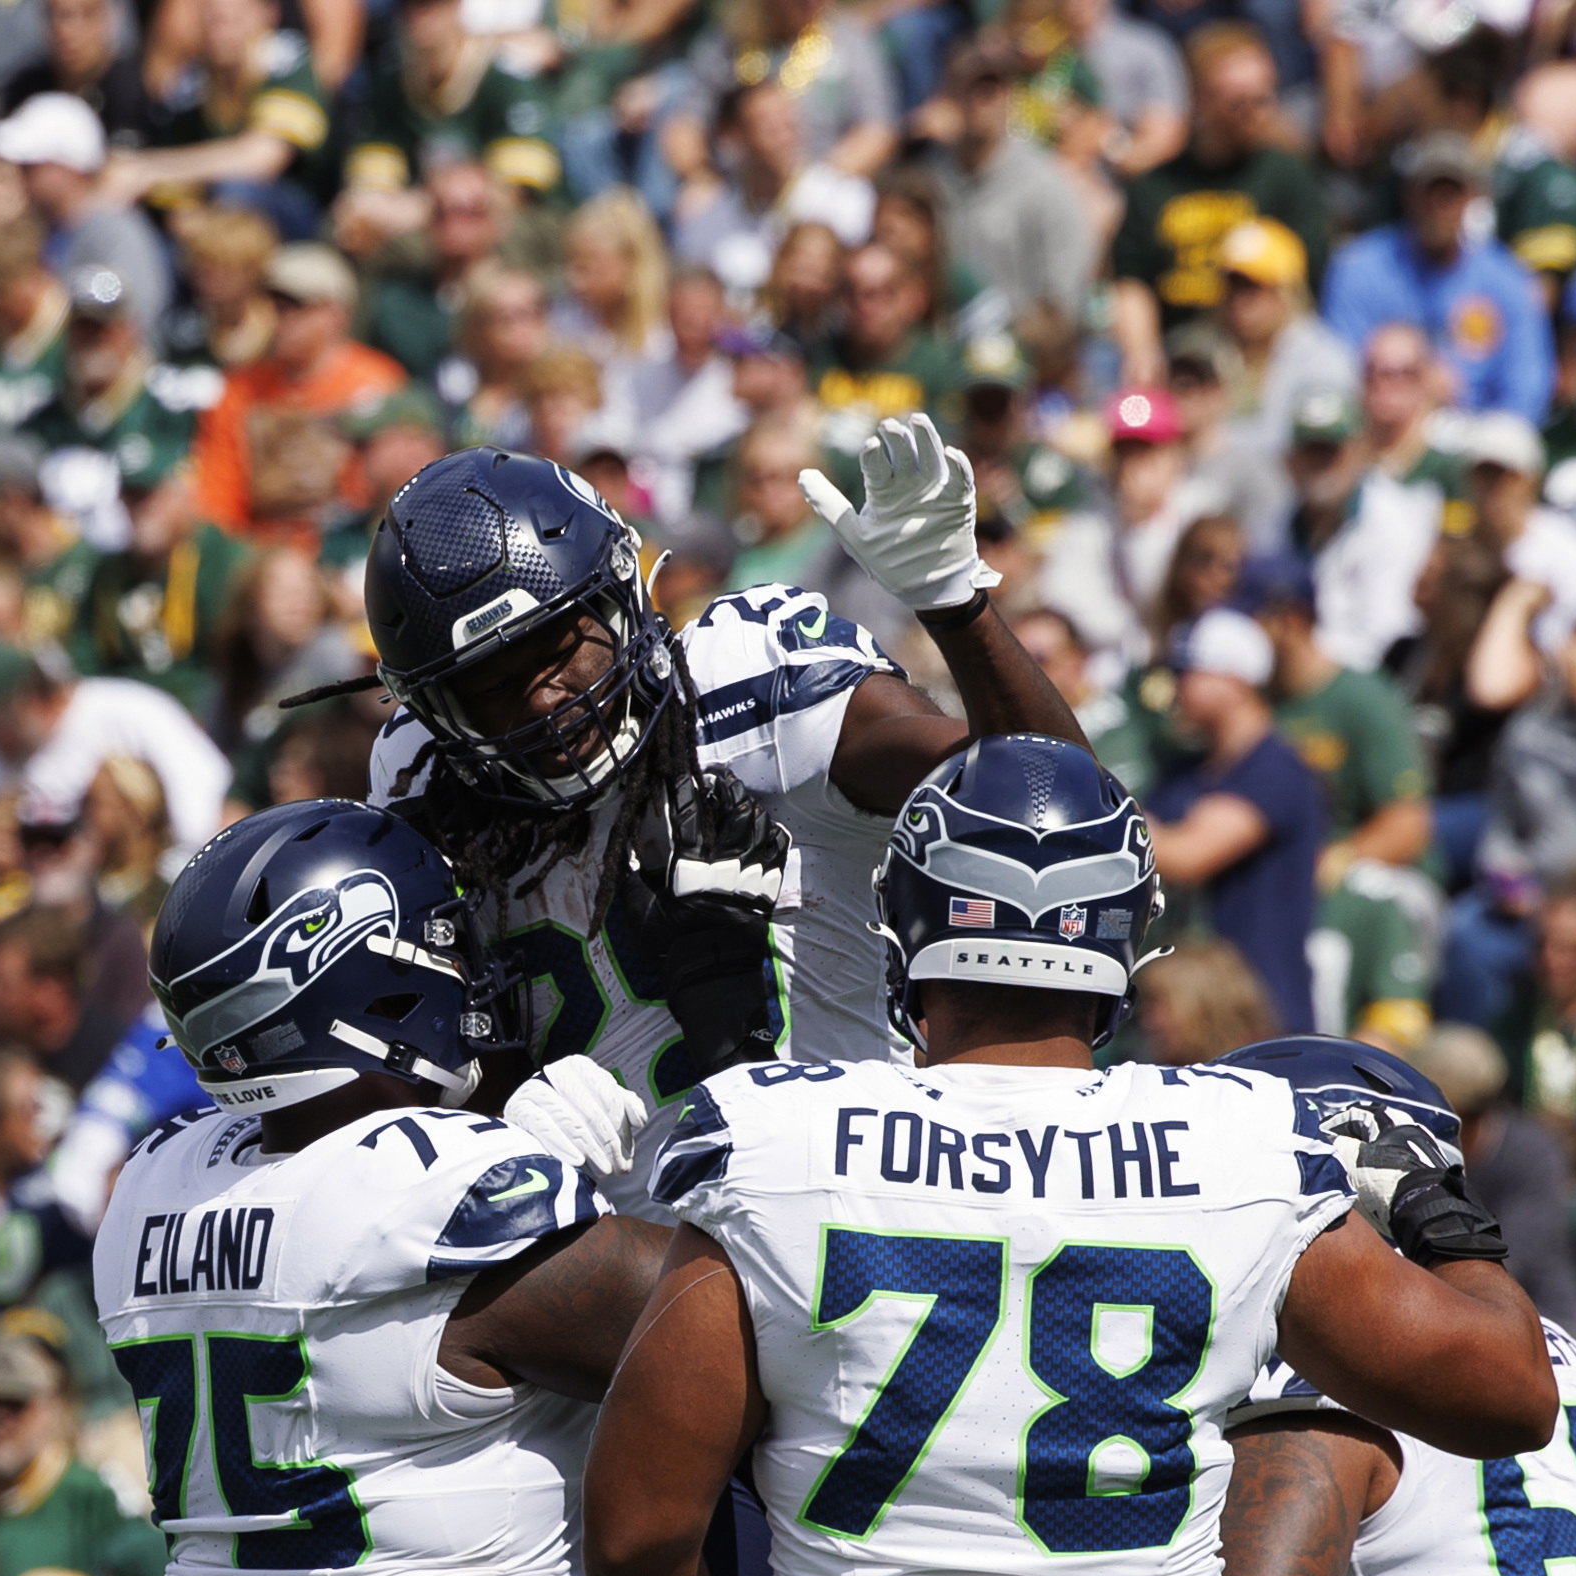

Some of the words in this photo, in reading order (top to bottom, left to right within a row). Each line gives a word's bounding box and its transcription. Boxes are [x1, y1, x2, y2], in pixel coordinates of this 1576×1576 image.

[465, 599, 513, 634] SEAHAWKS
[696, 697, 757, 728] AHAWKS
[1063, 920, 1082, 934] NFL
[957, 952, 1094, 975] SEATTLE
[232, 1086, 276, 1103] LOVE
[835, 1107, 1201, 1199] FORSYTHE
[133, 1207, 275, 1298] EILAND
[795, 1223, 1218, 1558] 78
[107, 1329, 374, 1571] 75
